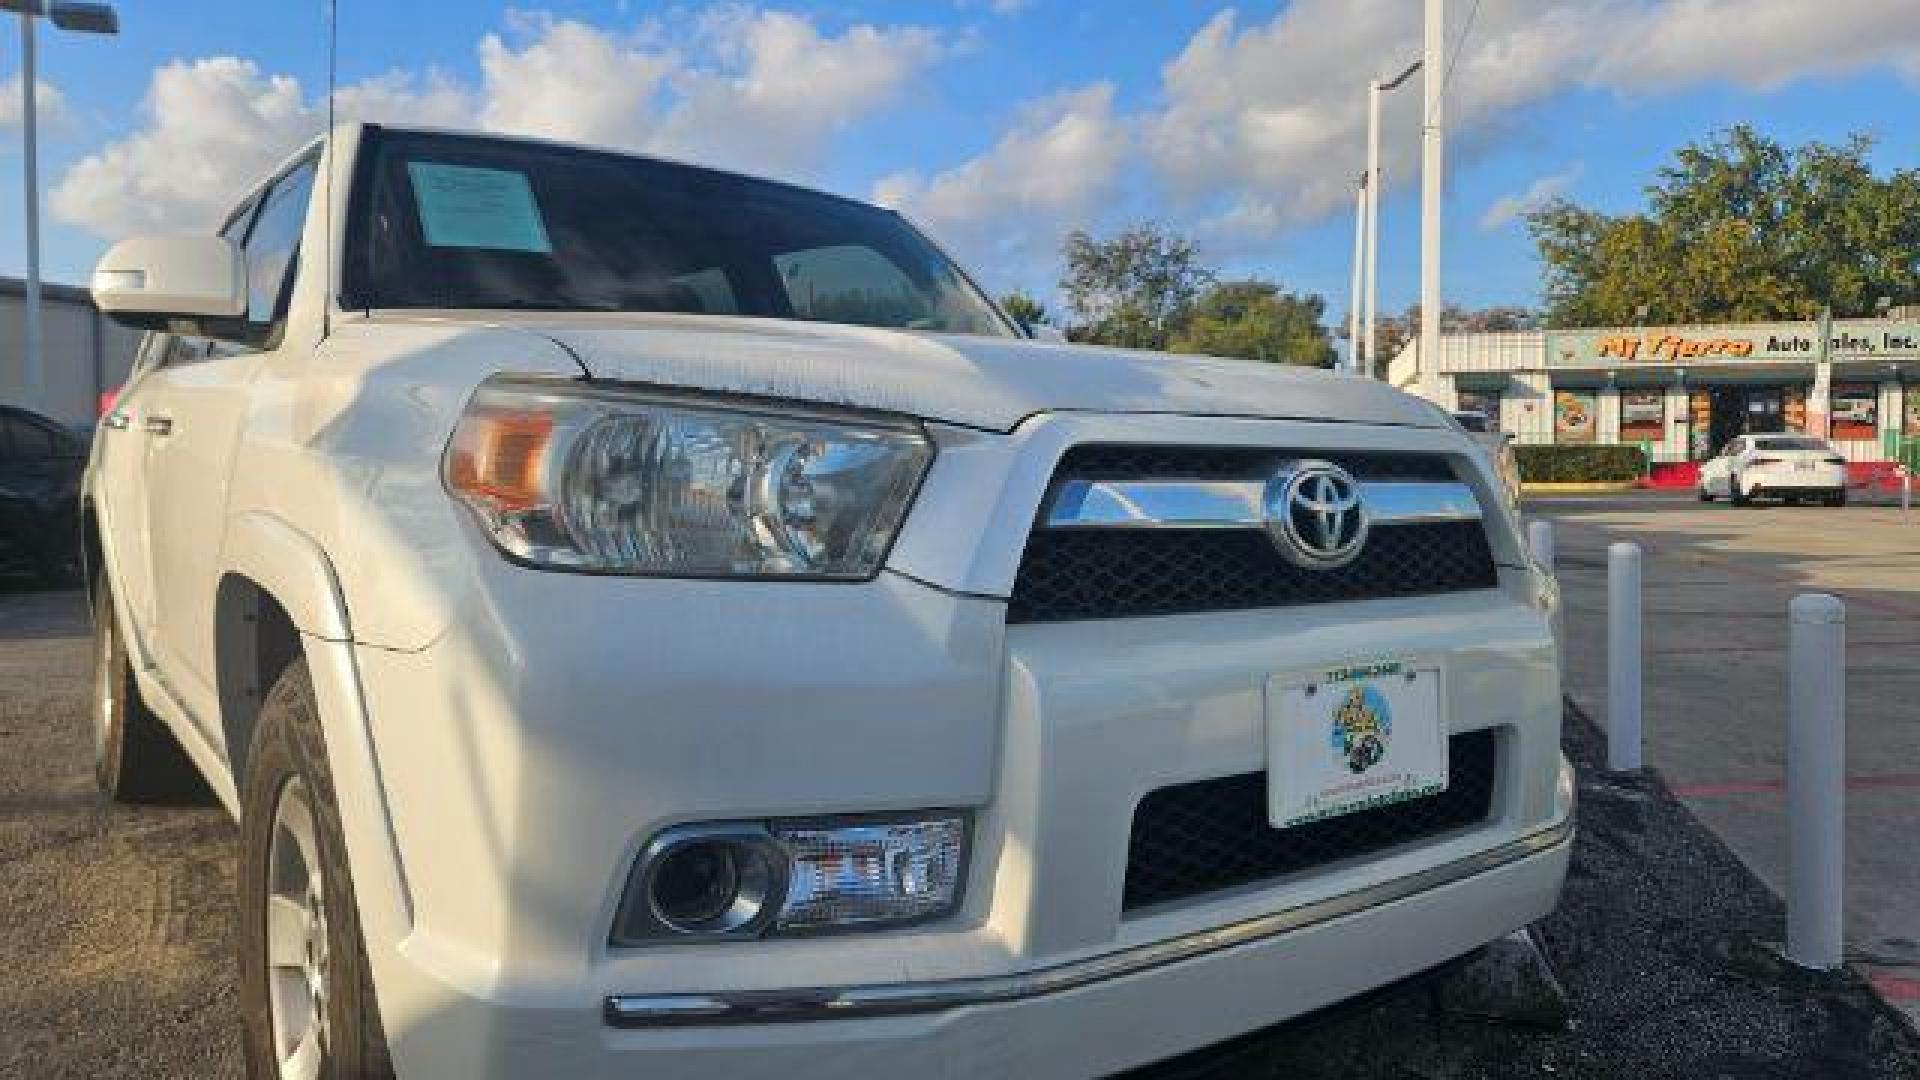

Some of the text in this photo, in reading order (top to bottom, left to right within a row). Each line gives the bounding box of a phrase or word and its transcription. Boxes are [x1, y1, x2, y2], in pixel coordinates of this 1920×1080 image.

[1766, 335, 1811, 352] Auto
[1818, 333, 1875, 352] ales,
[1883, 331, 1918, 349] Inc.
